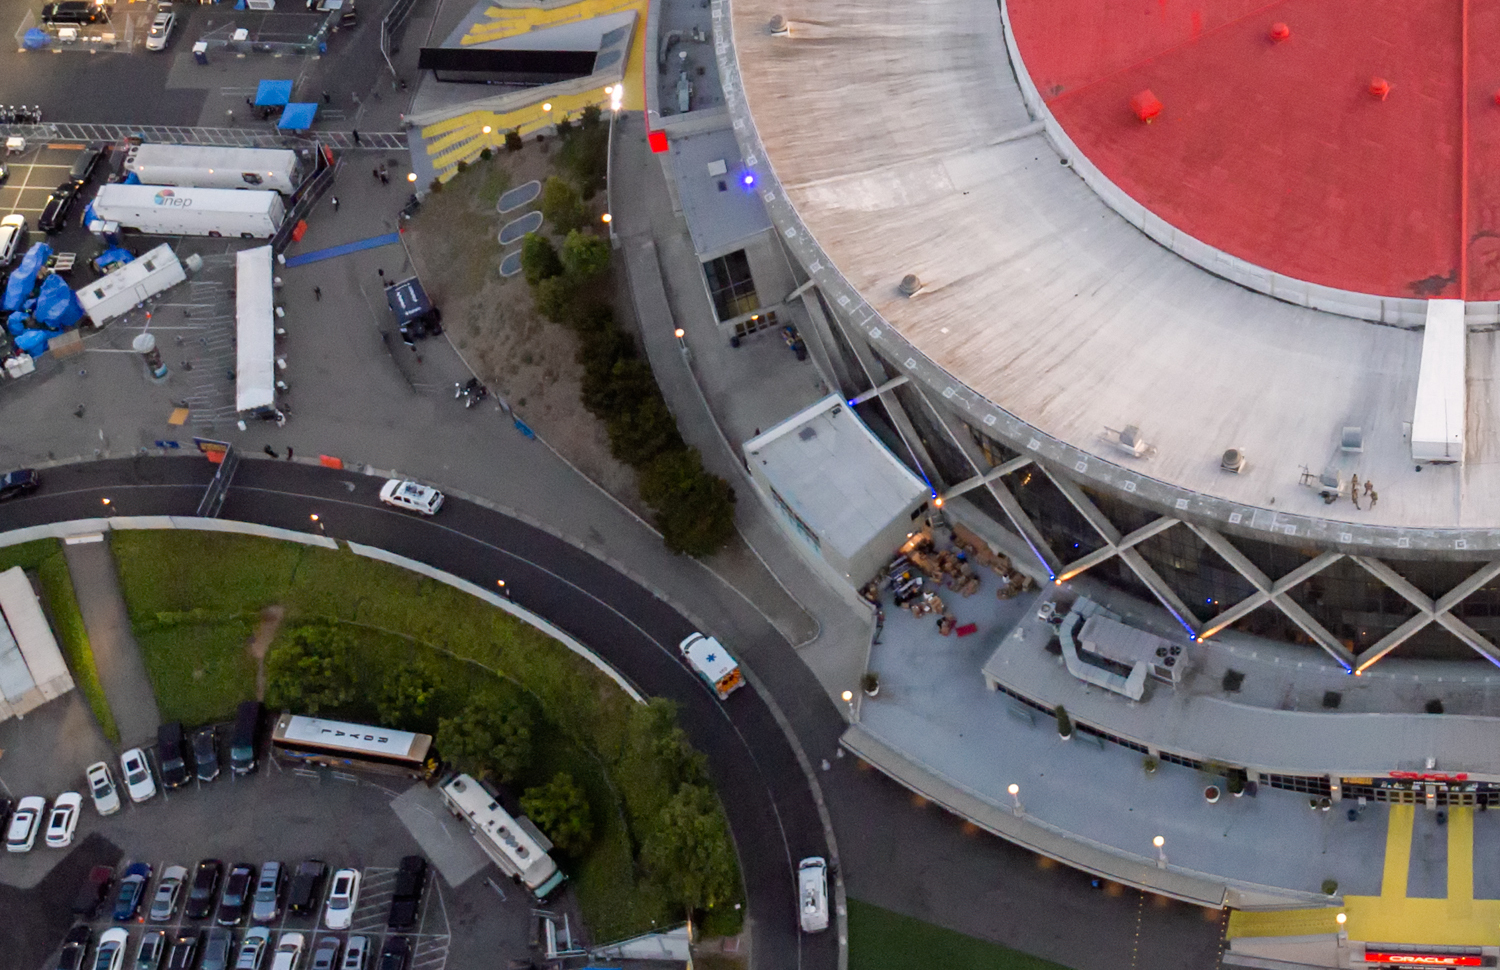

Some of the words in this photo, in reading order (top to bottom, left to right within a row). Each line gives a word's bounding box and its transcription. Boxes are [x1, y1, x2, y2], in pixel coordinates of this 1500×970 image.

[163, 194, 193, 209] nep
[321, 728, 389, 744] ROYAL
[1389, 955, 1454, 964] ORACLE
